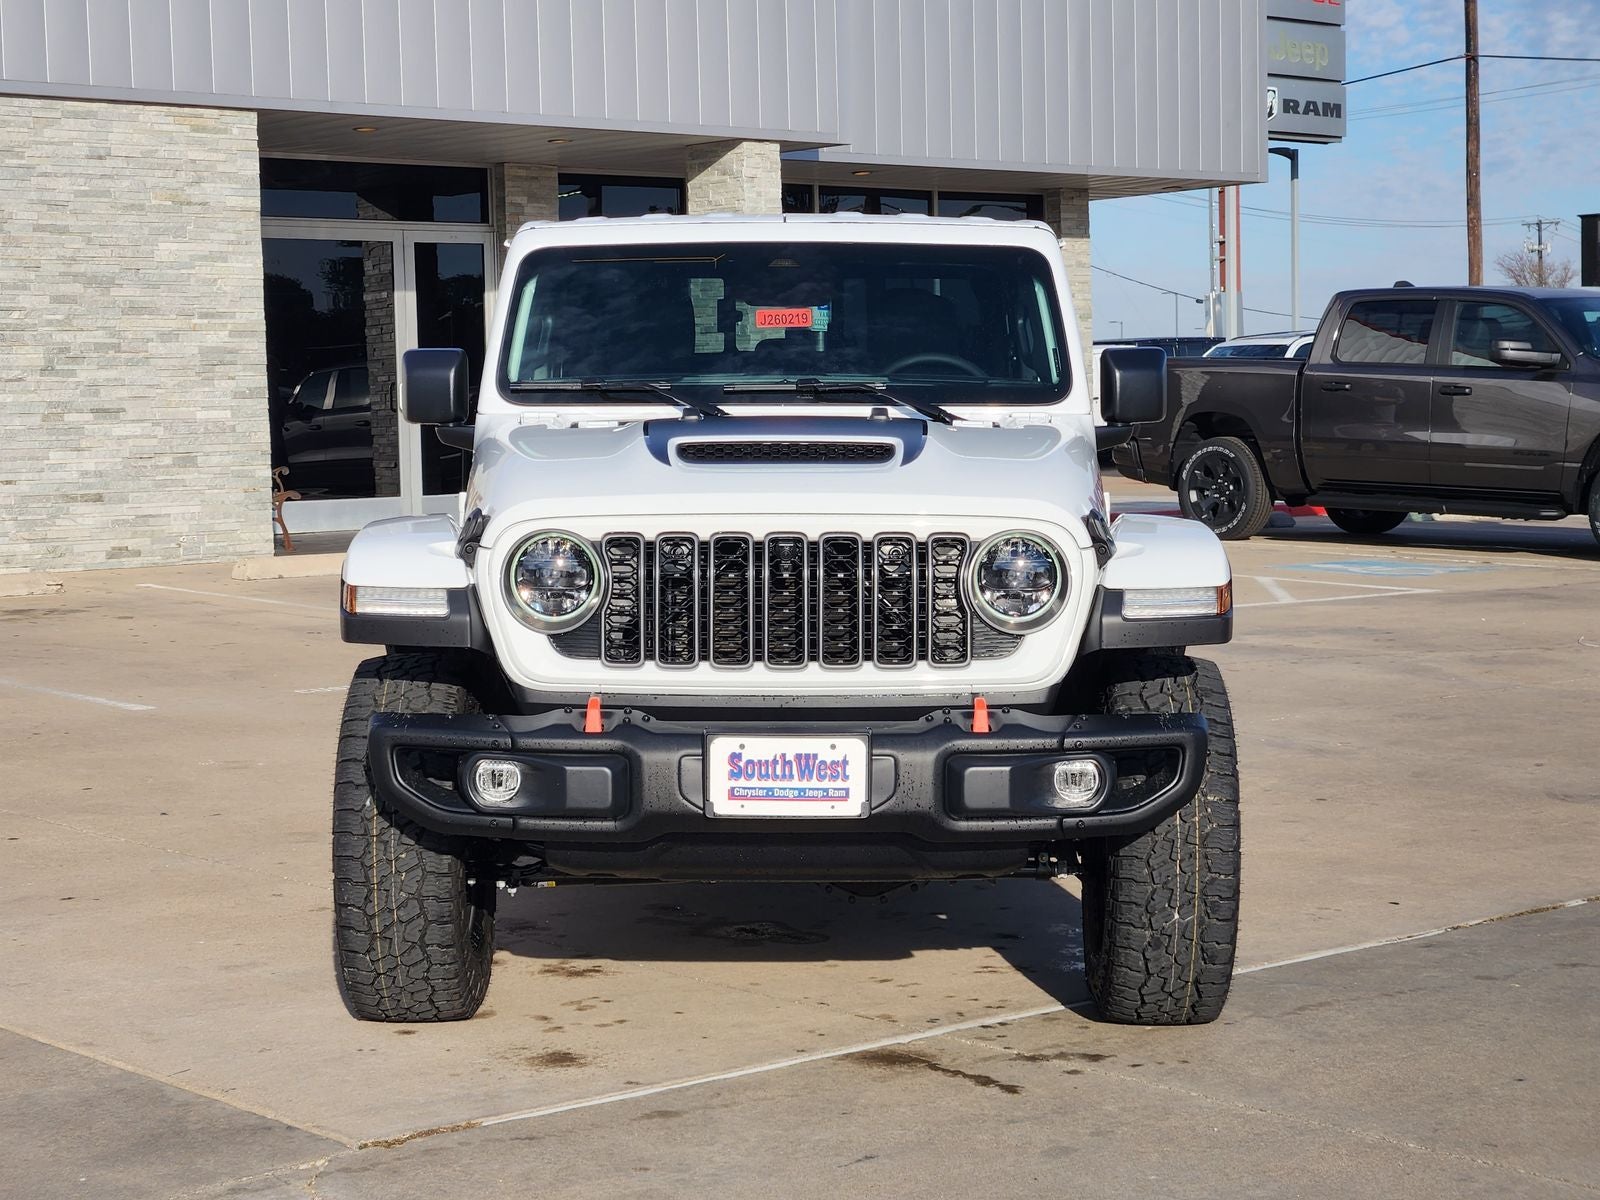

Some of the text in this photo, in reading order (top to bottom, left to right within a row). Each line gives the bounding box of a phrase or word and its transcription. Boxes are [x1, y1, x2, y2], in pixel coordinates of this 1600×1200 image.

[1267, 29, 1329, 71] Jeep
[1282, 98, 1342, 118] RAM
[760, 313, 808, 325] J260219
[728, 752, 849, 782] SouthWest
[734, 787, 846, 798] Chrysler Dodge Jeep Ram
